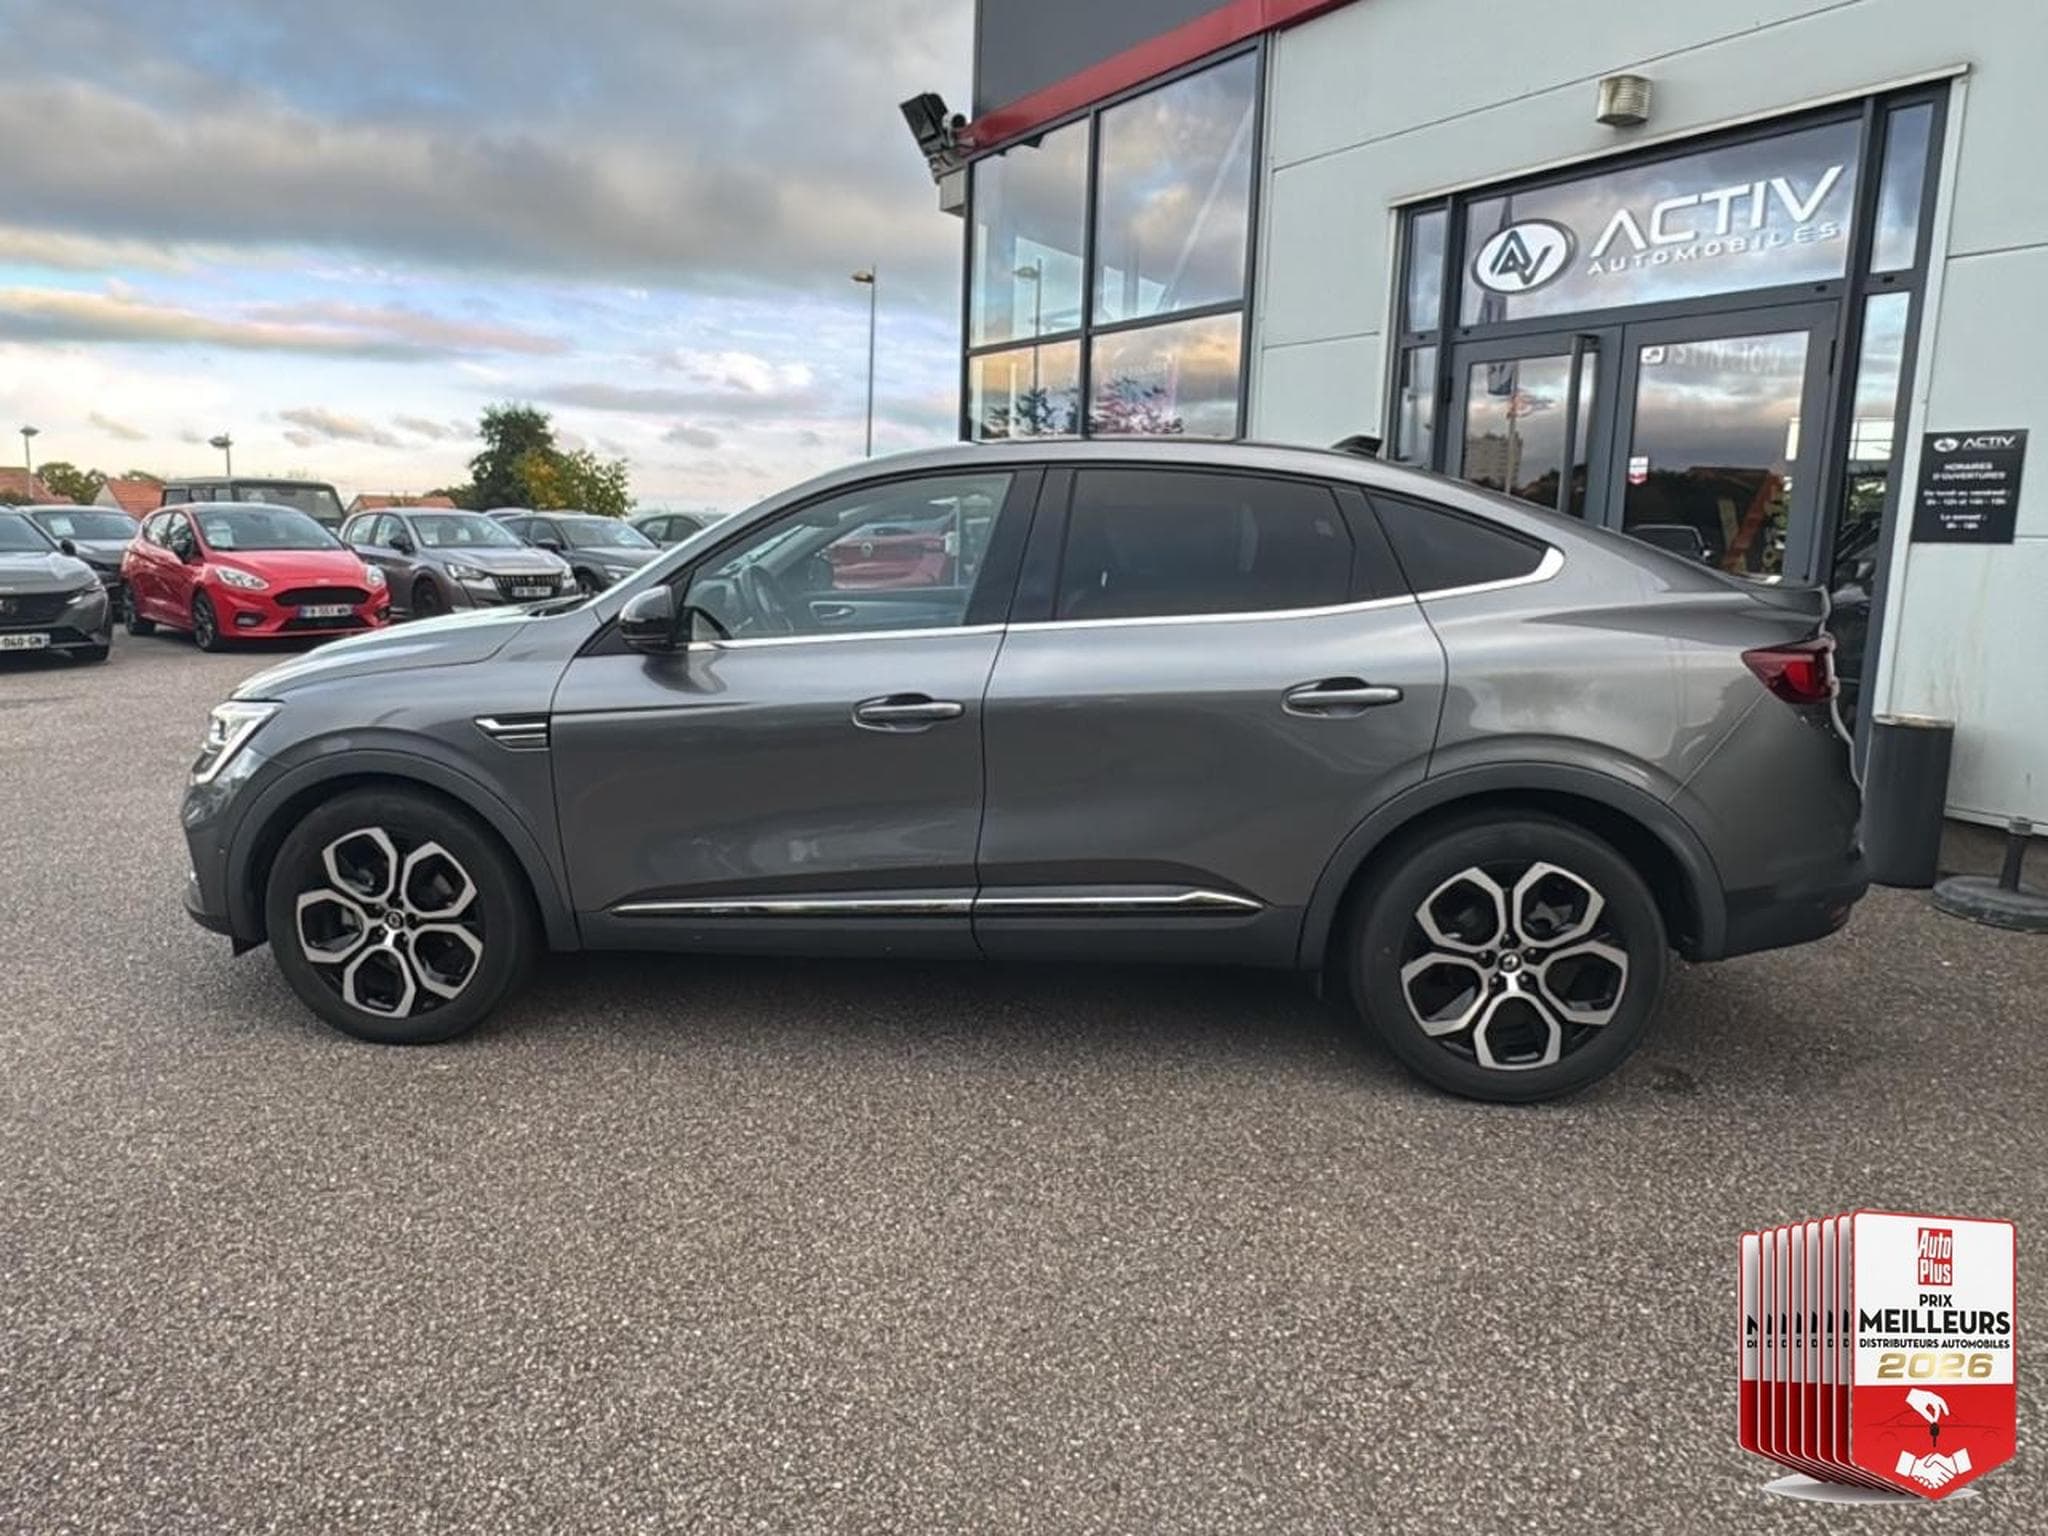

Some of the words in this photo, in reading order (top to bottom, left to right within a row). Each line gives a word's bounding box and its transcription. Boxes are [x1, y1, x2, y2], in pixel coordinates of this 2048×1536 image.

[1590, 165, 1844, 259] ACTIV
[1587, 222, 1842, 276] AUTOMOBILES
[1962, 435, 2016, 448] ACTIV
